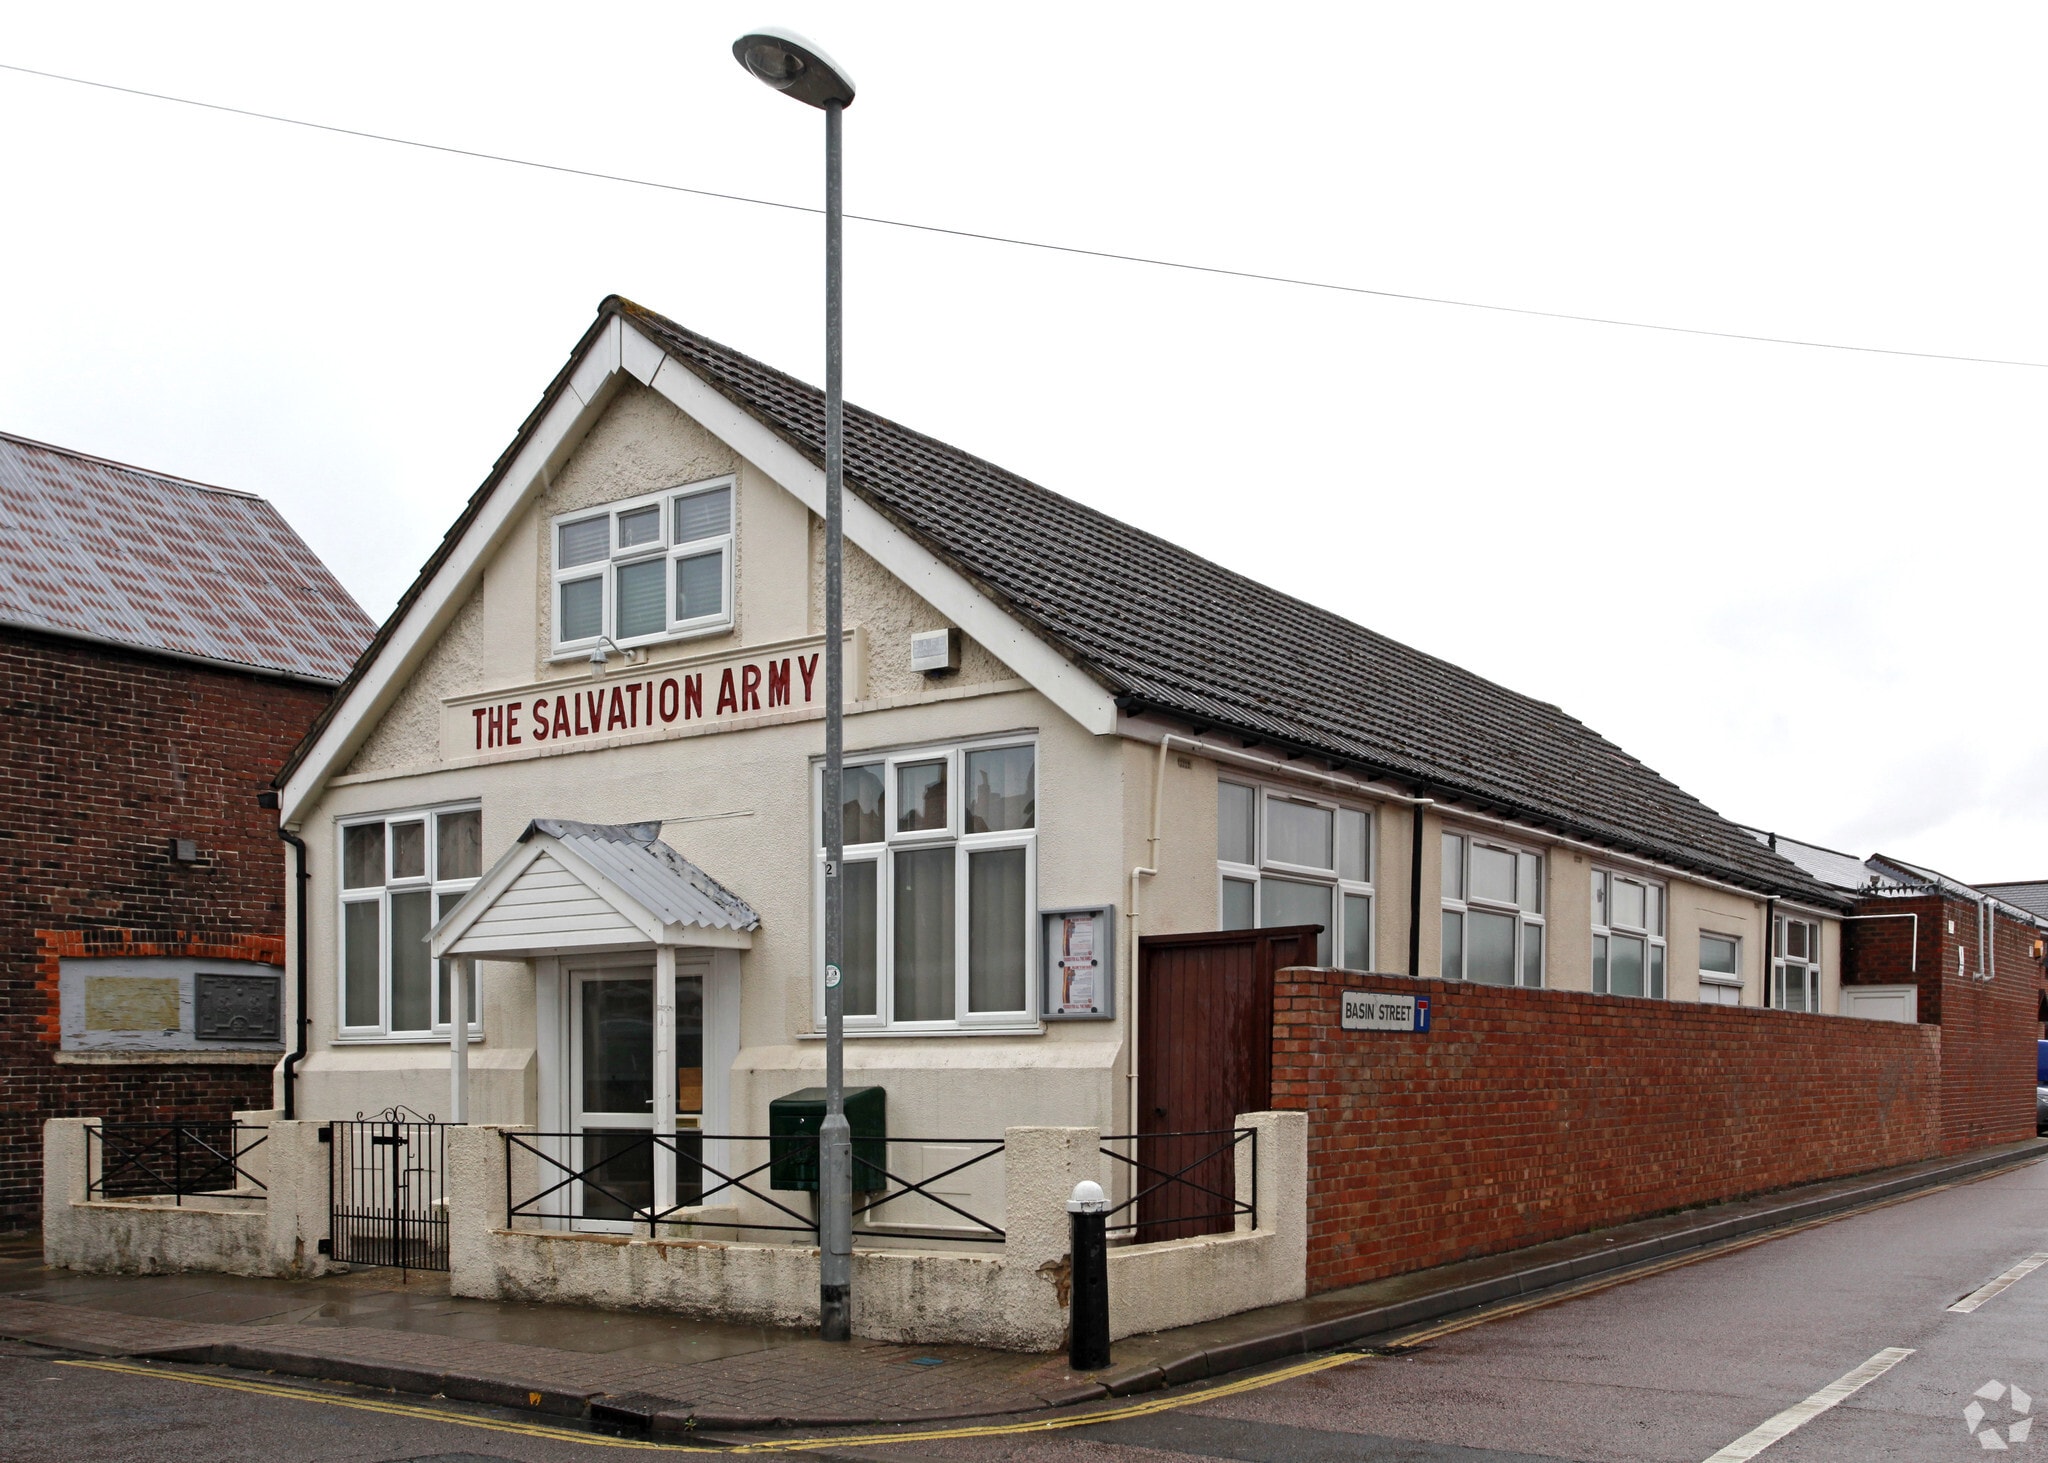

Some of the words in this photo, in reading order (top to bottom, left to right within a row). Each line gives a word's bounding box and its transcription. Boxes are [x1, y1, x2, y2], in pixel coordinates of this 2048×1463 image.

[473, 703, 522, 750] THE
[533, 674, 703, 741] SALVATION
[717, 654, 820, 715] ARMY
[826, 864, 833, 875] 2
[1345, 1002, 1375, 1020] BASIN
[1378, 1004, 1412, 1021] STREET
